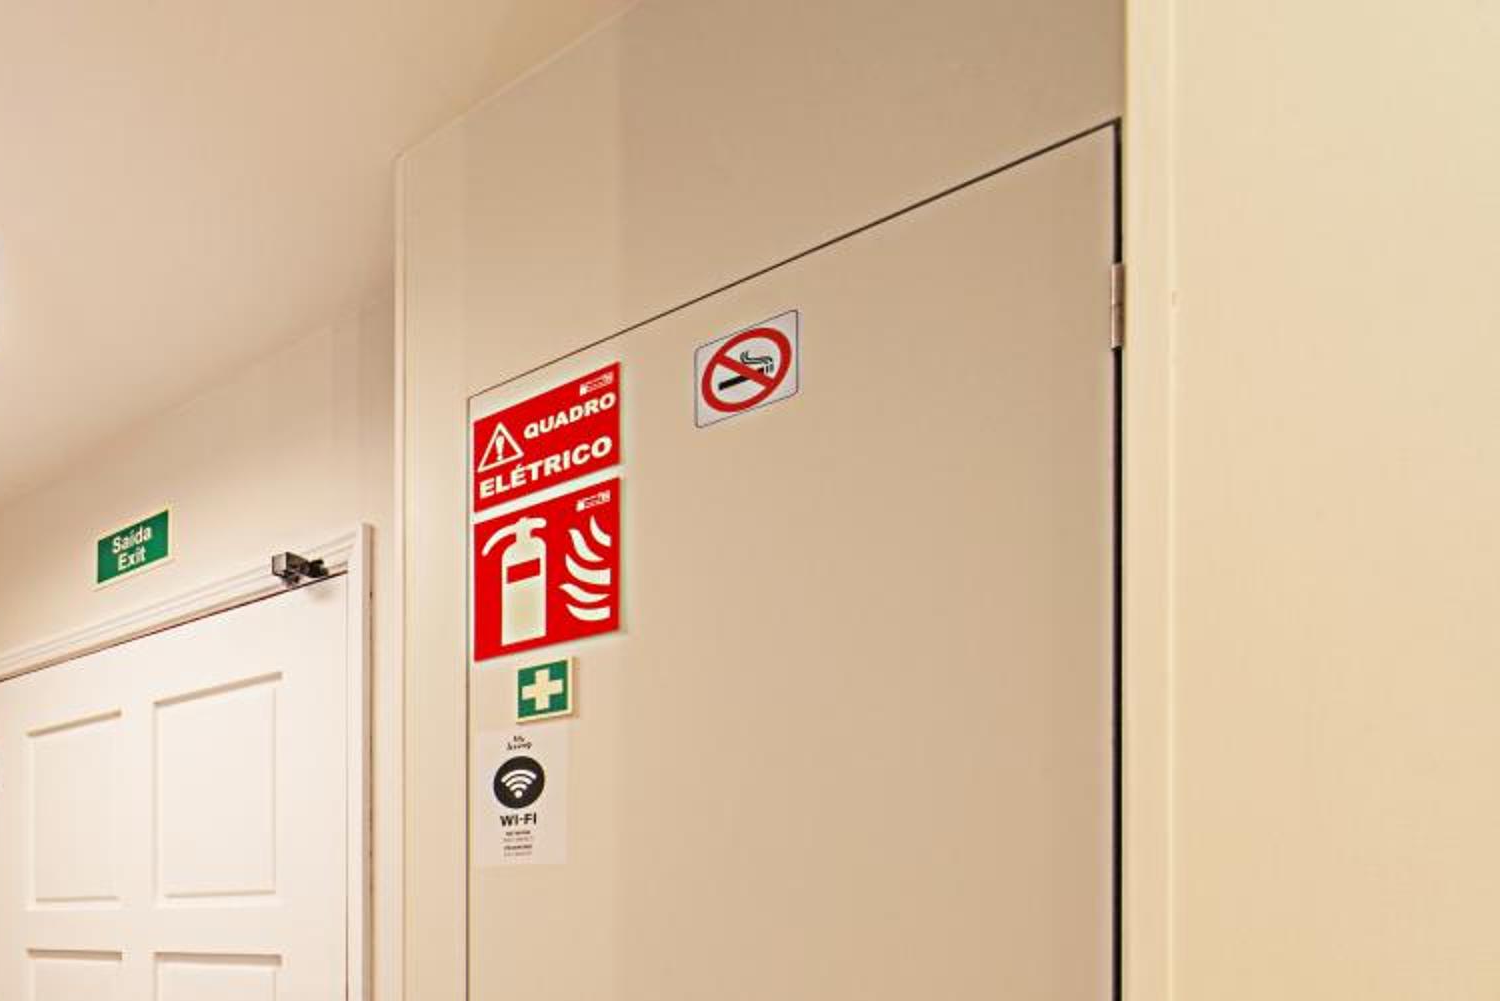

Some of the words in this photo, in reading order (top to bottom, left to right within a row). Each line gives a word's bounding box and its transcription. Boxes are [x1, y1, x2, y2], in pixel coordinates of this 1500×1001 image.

[523, 392, 616, 439] QUADRO
[479, 436, 612, 498] ELÉTRICO
[118, 546, 146, 571] Exit
